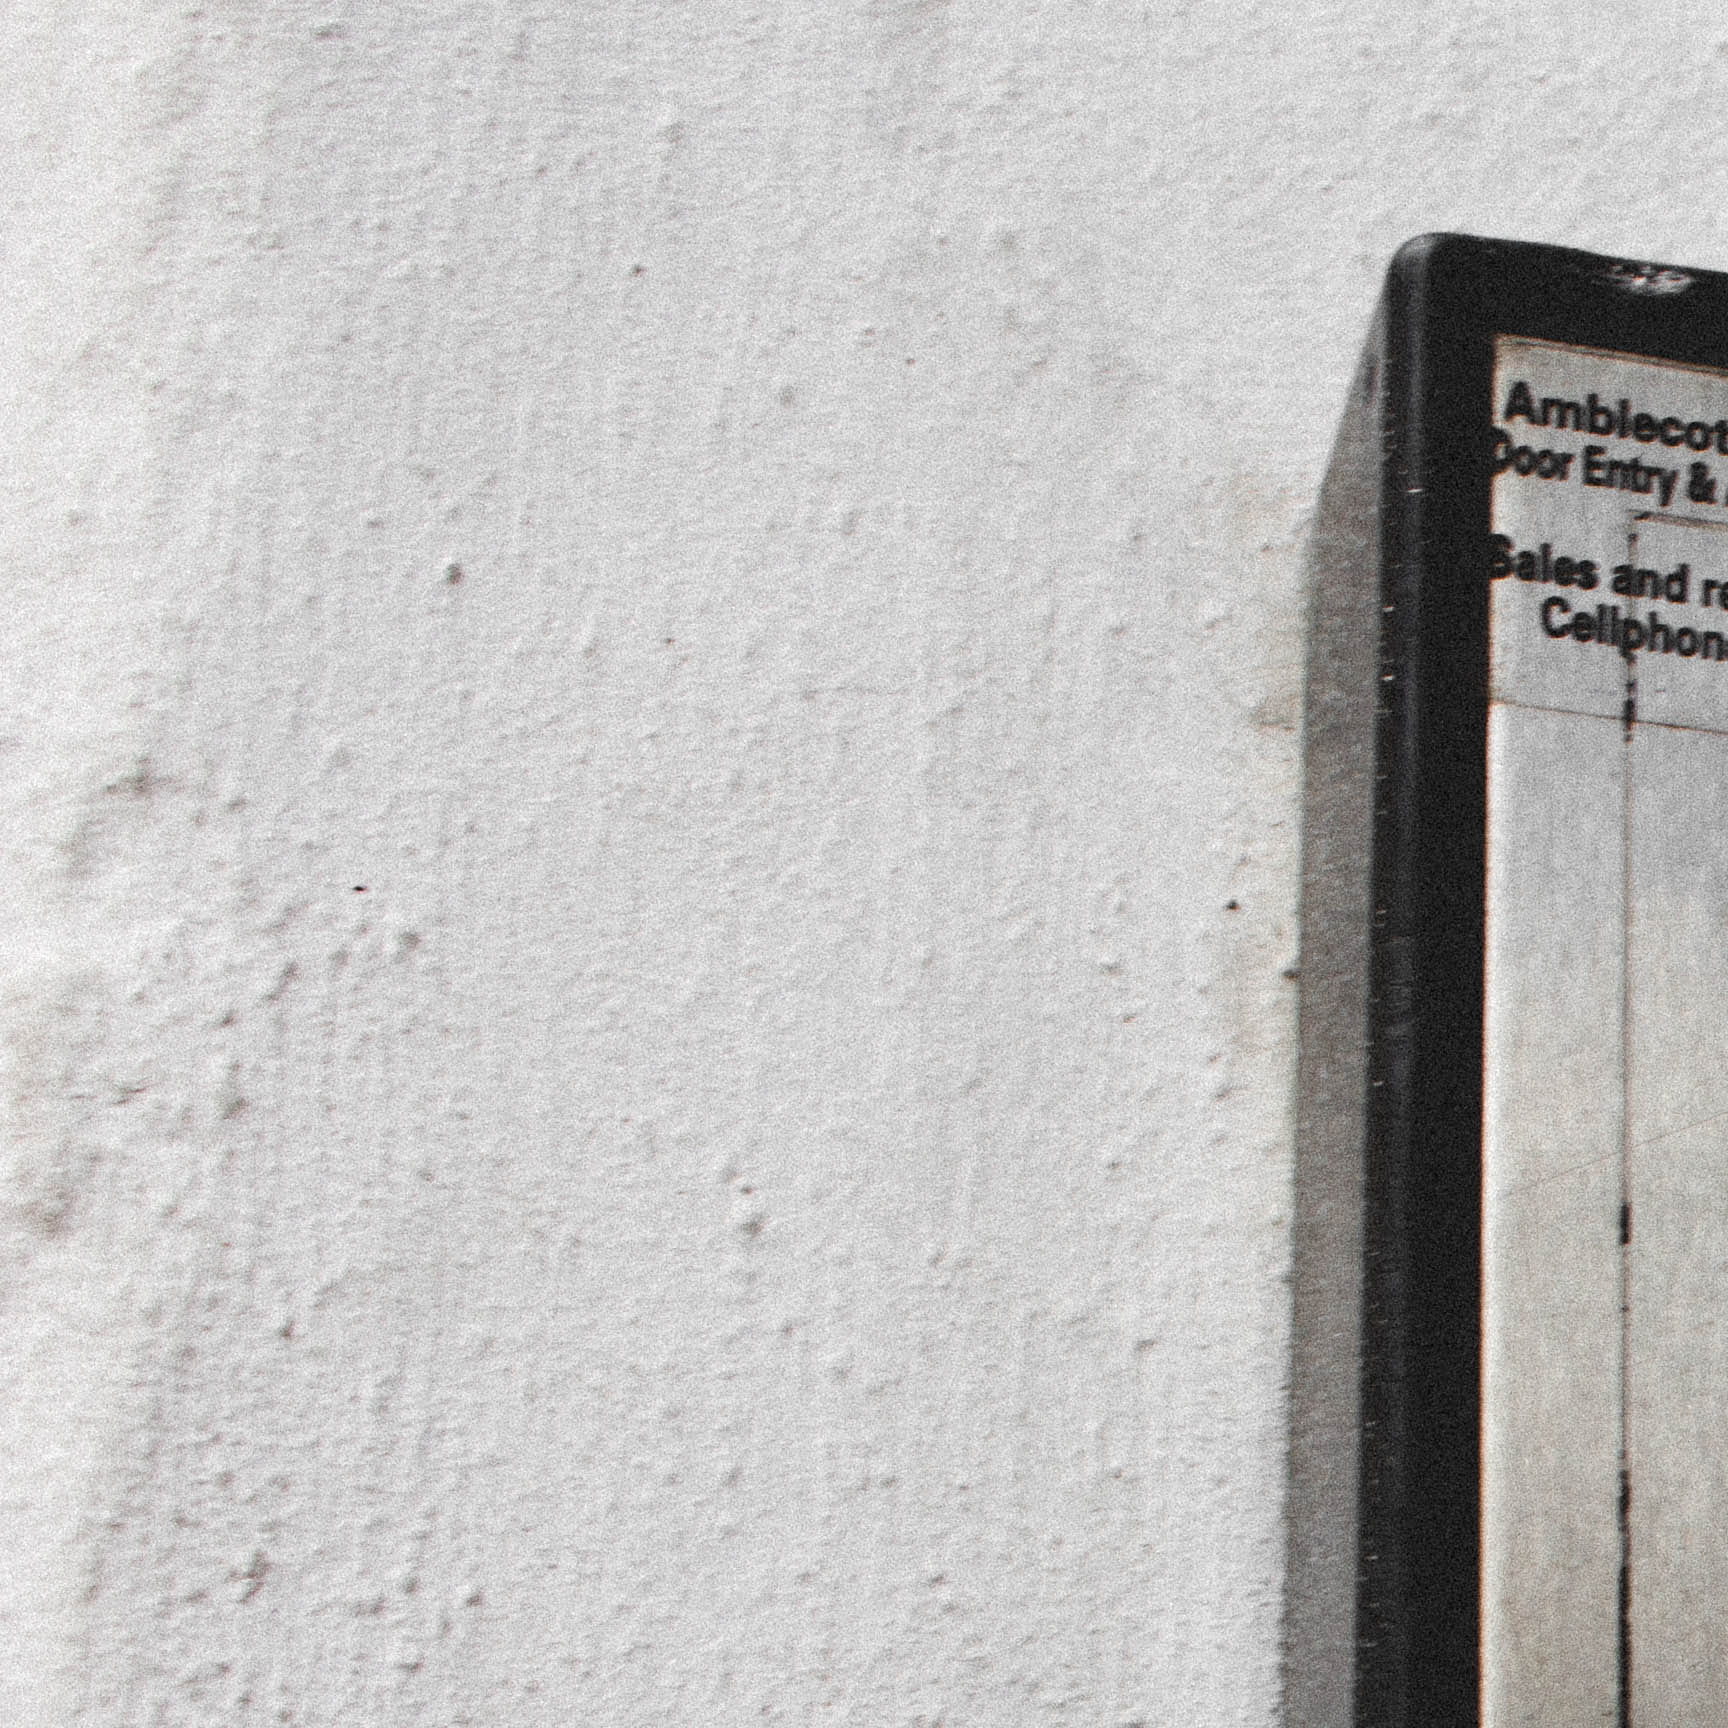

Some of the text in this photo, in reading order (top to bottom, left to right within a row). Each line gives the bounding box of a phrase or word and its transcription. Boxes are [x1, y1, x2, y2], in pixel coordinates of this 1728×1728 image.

[1583, 444, 1680, 507] Entry
[1686, 462, 1718, 504] &
[1489, 533, 1599, 590] Sales
[1611, 563, 1690, 605] and
